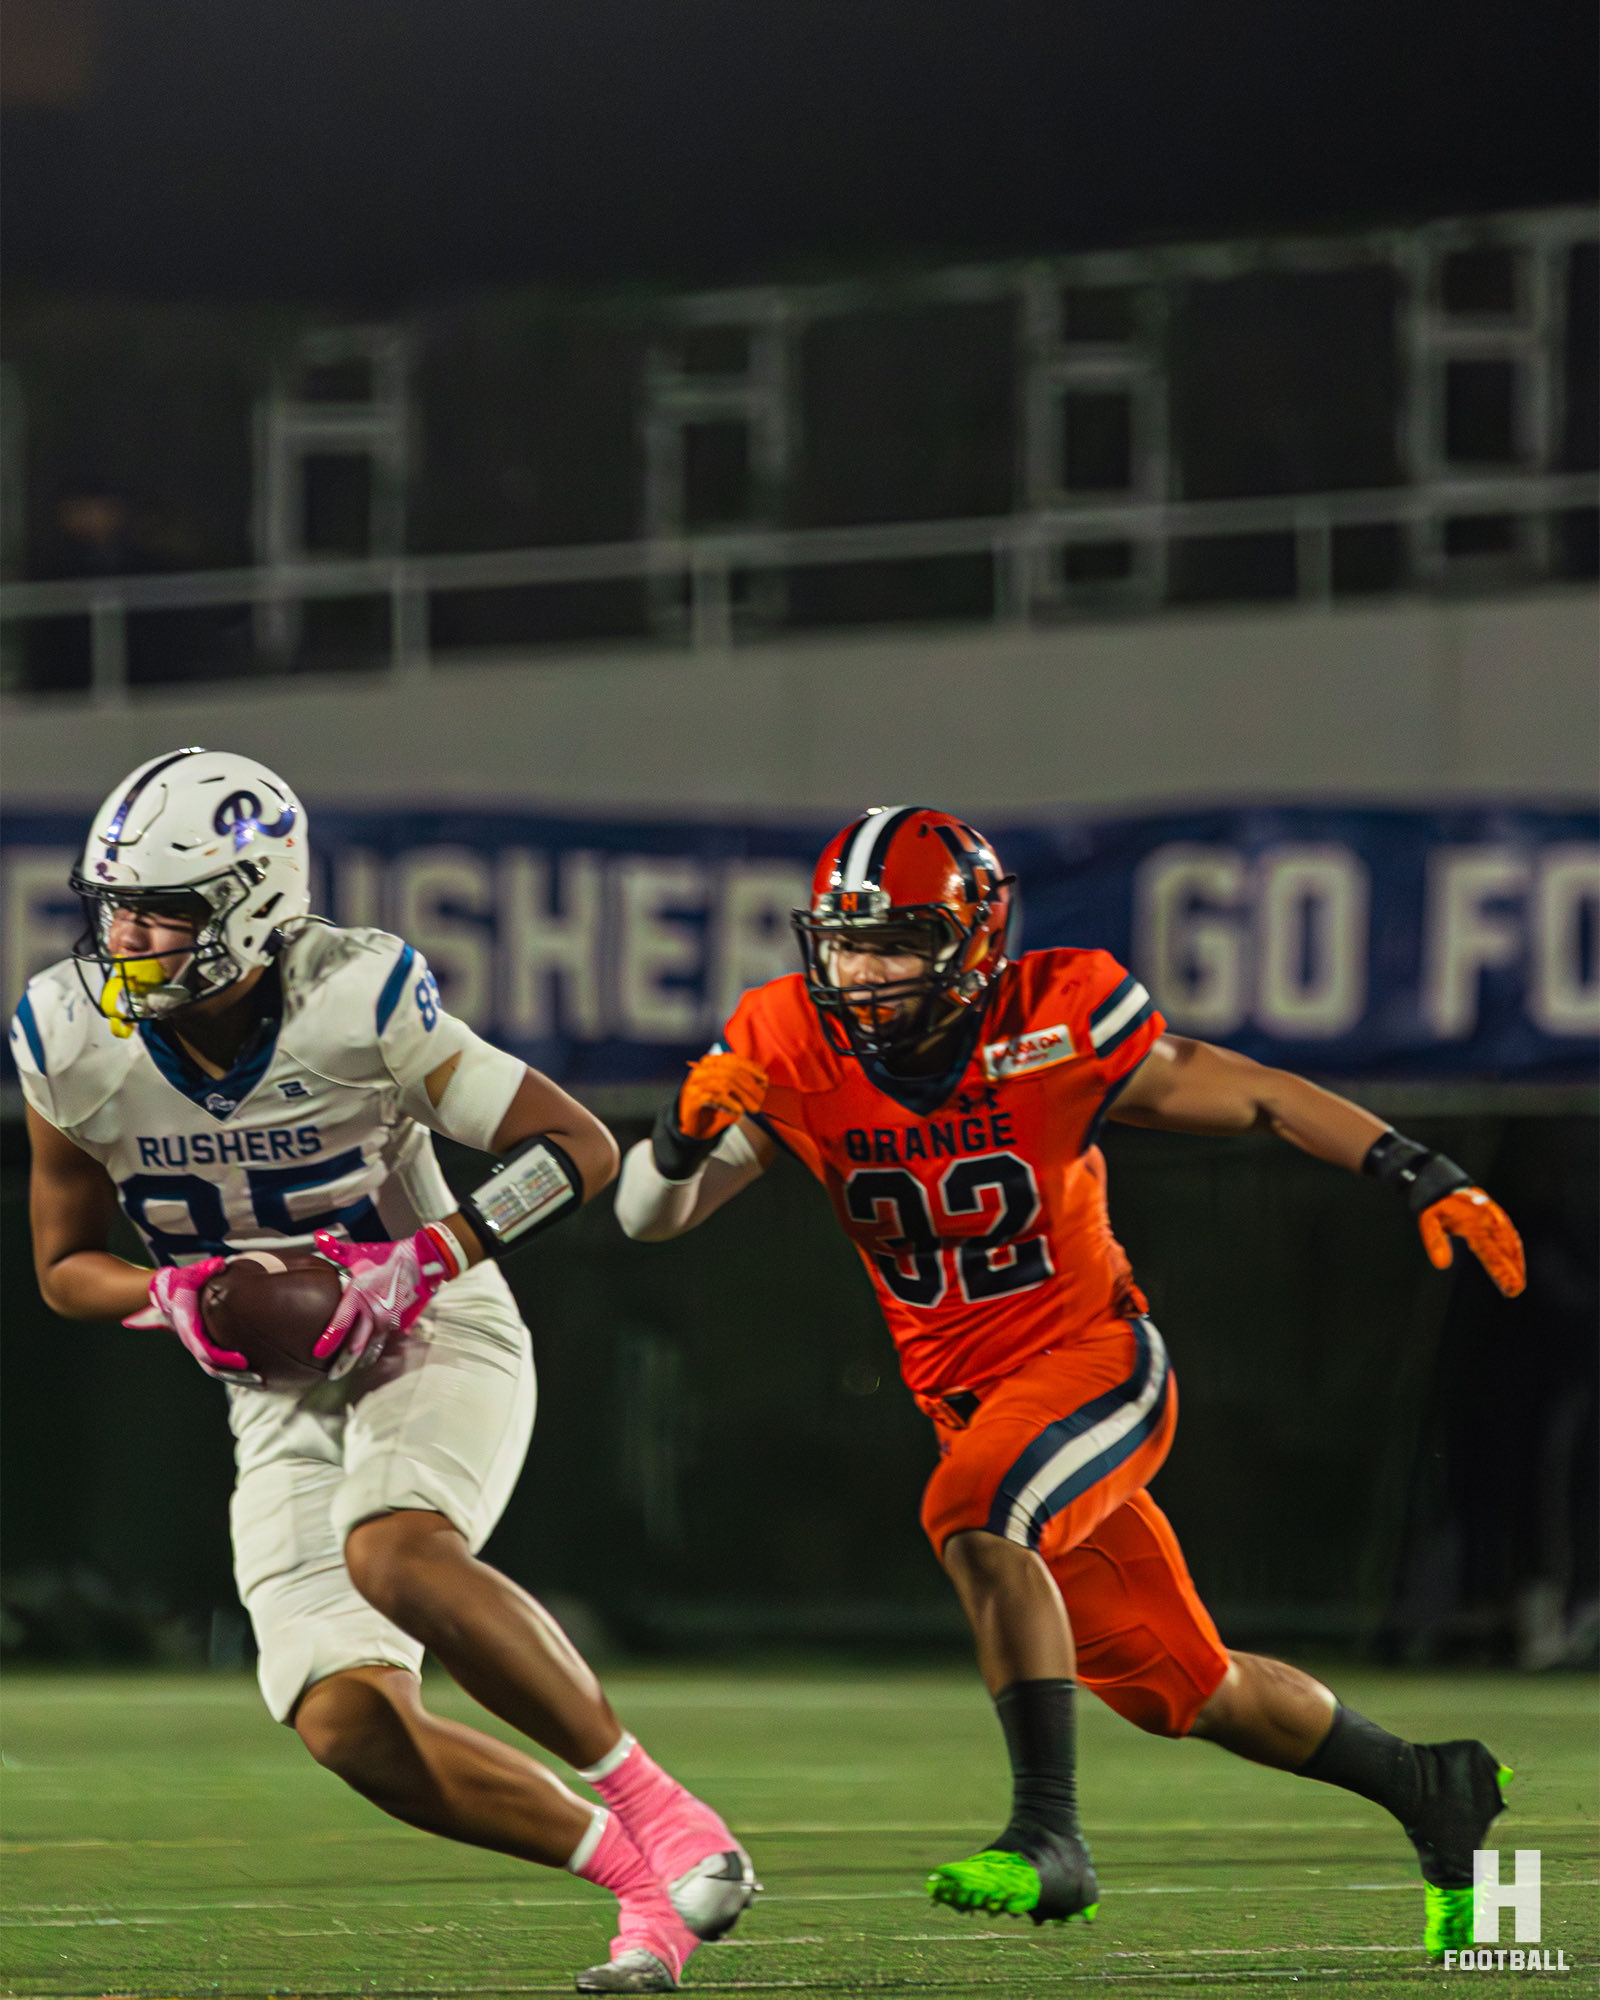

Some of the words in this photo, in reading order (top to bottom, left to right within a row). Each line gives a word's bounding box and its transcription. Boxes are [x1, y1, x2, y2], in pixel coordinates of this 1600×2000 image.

[1136, 842, 1370, 1040] GO
[137, 1125, 323, 1168] RUSHERS
[845, 1112, 1017, 1163] ORANGE
[846, 1150, 1055, 1309] 32
